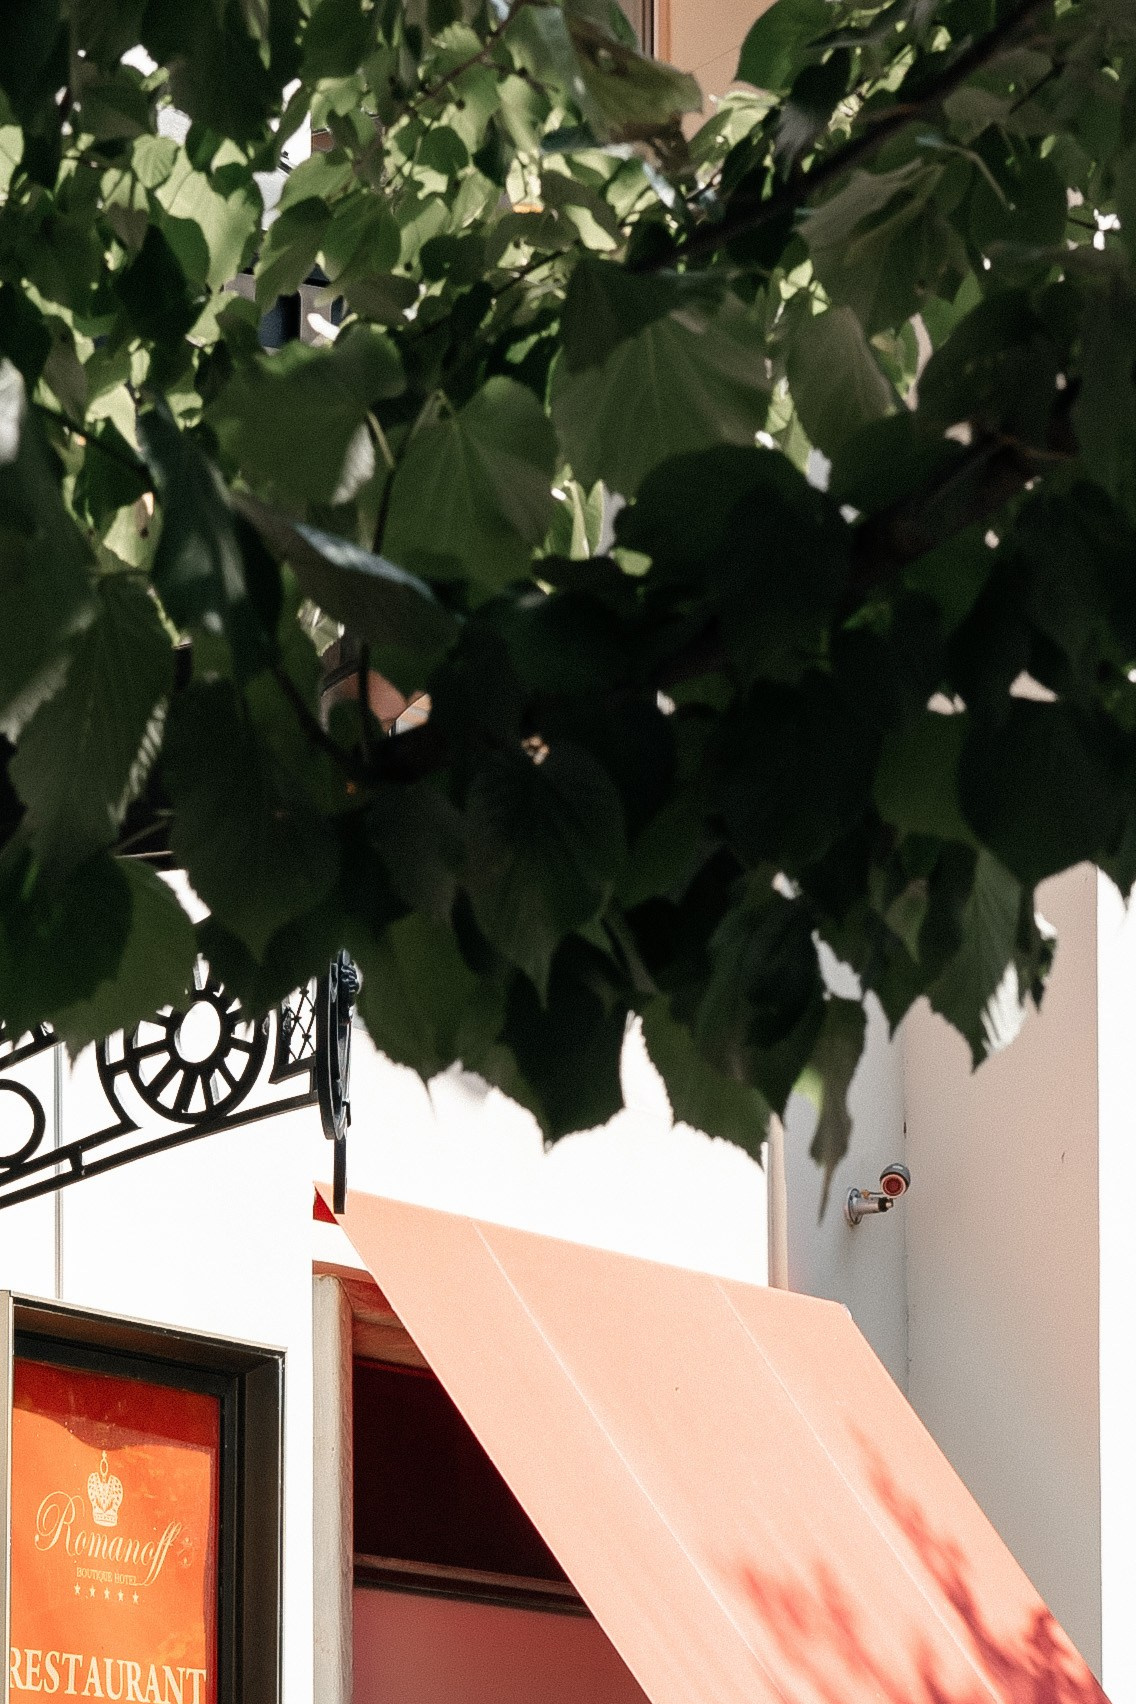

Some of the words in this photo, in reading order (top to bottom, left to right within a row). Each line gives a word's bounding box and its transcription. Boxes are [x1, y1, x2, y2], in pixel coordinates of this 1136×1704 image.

[34, 1490, 182, 1586] Romanoff
[76, 1567, 113, 1583] BOUTIQUE
[114, 1572, 138, 1586] HOTEL
